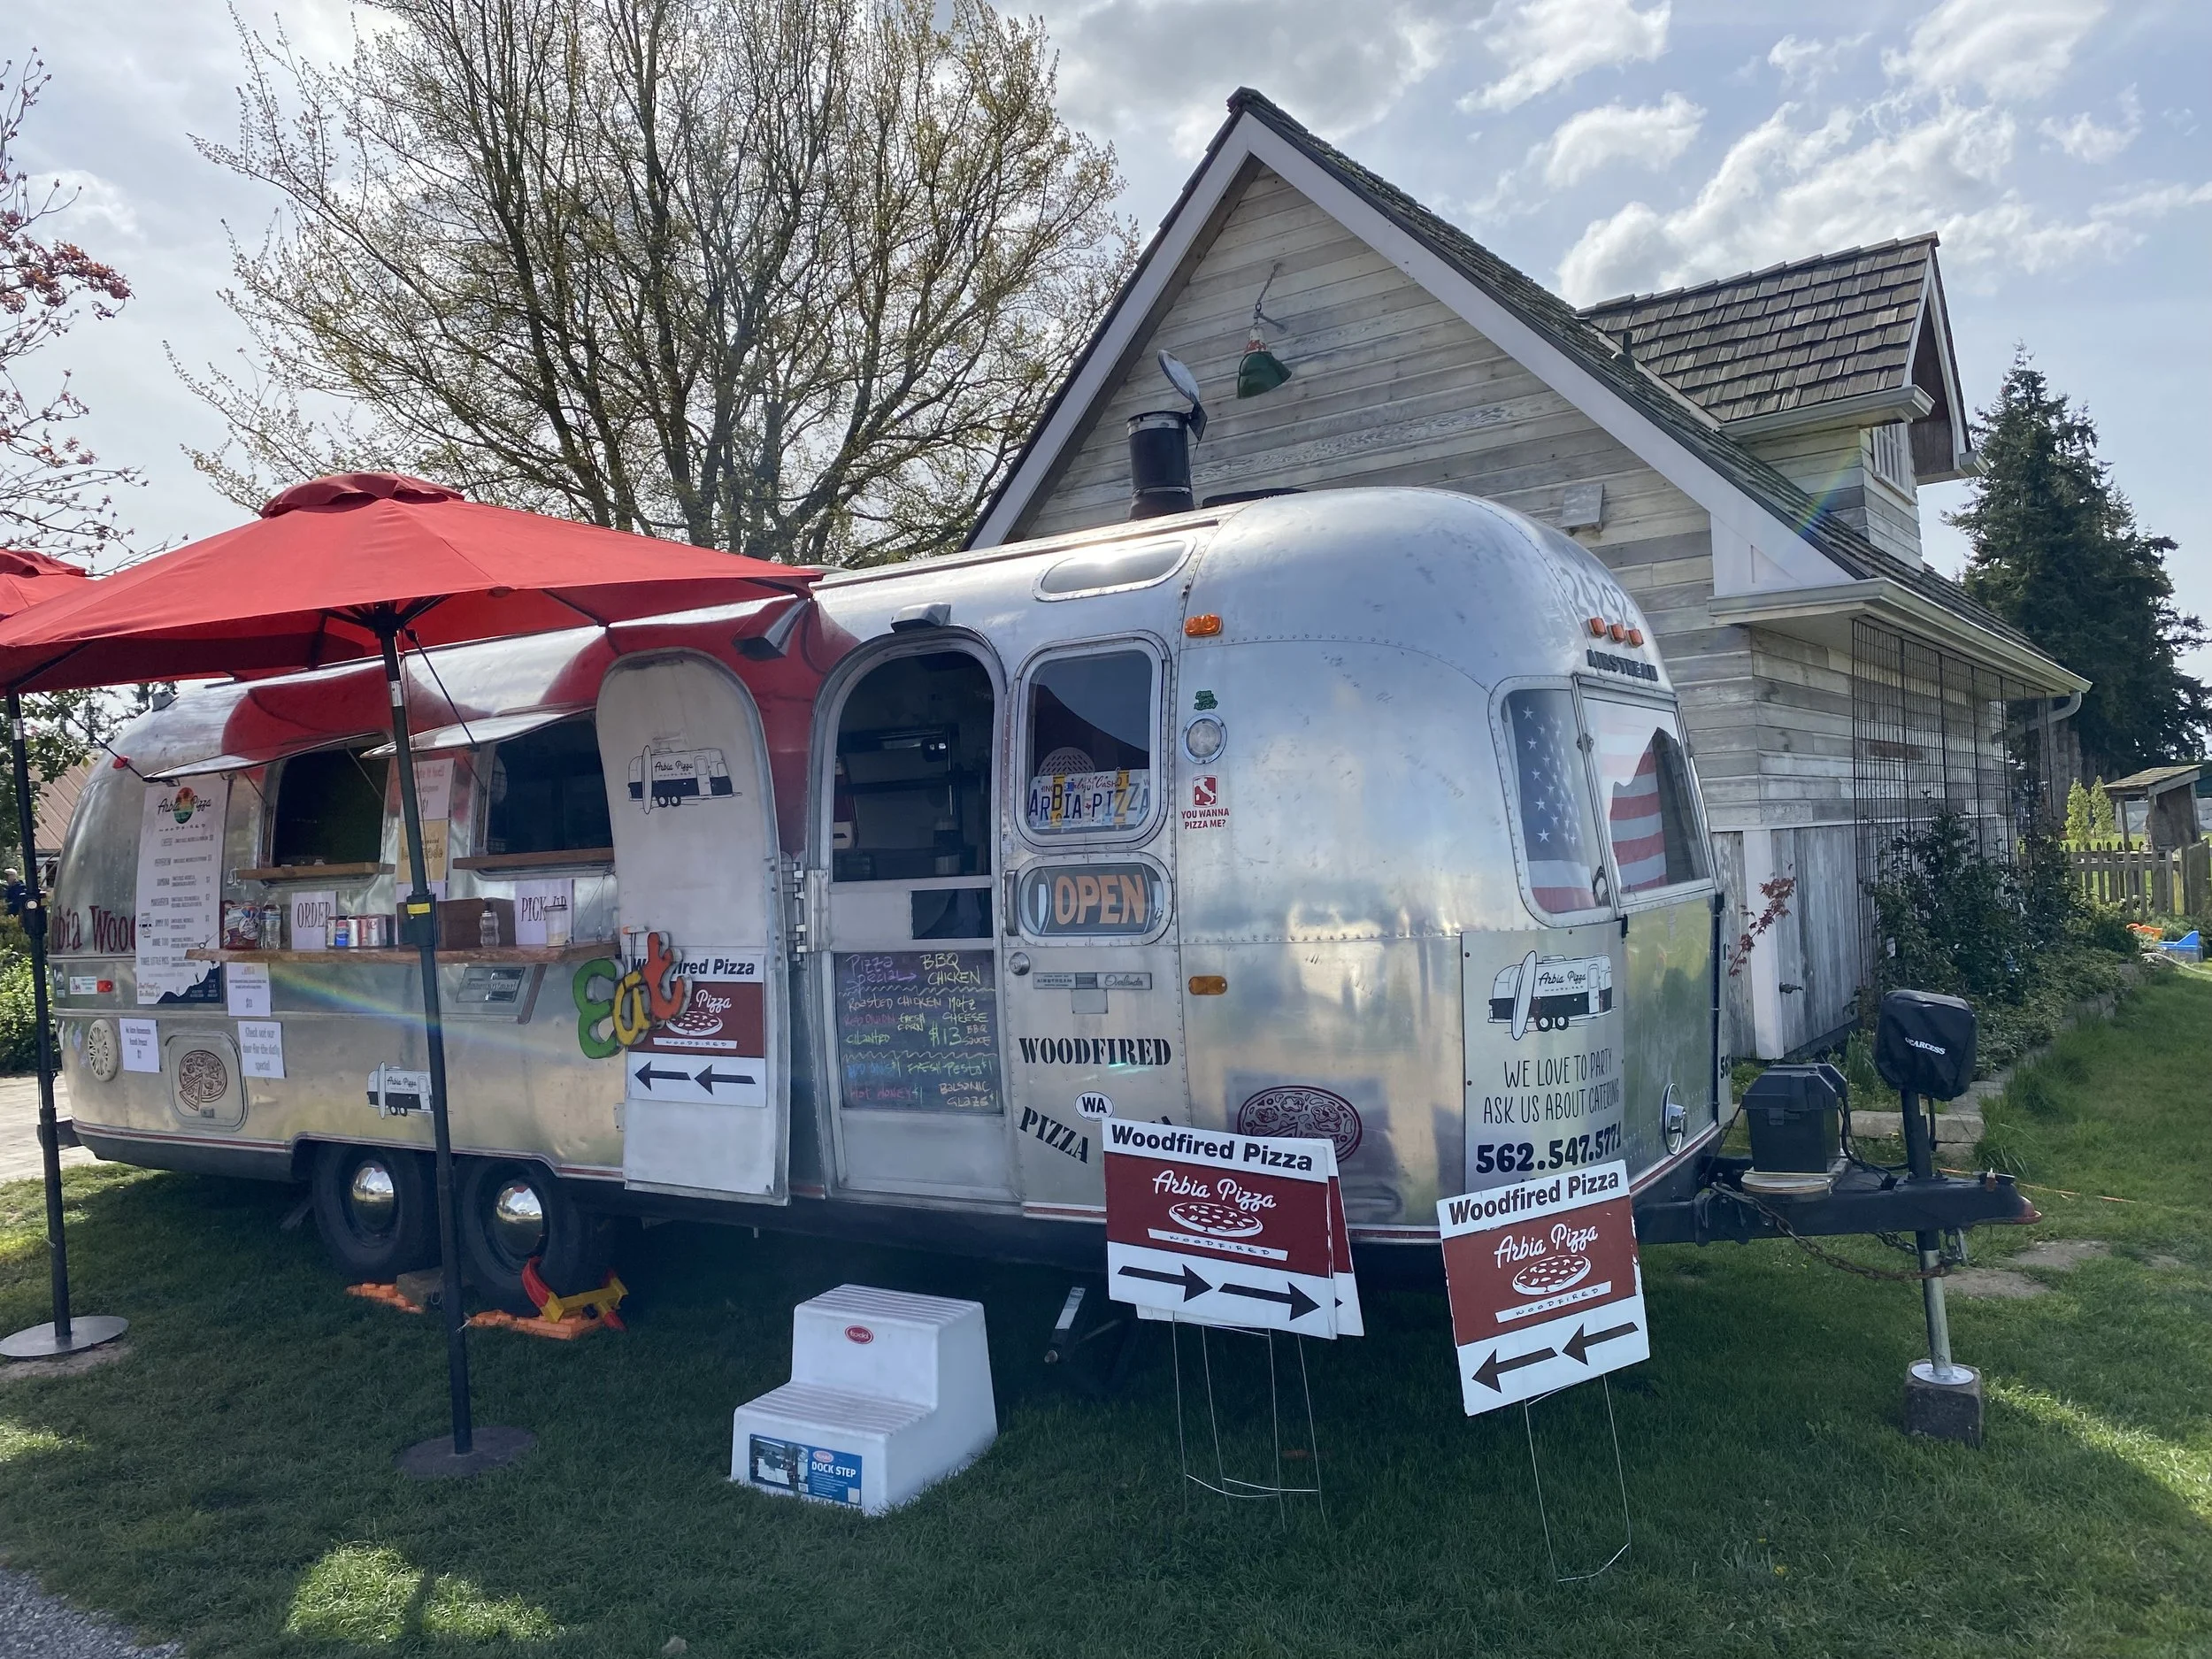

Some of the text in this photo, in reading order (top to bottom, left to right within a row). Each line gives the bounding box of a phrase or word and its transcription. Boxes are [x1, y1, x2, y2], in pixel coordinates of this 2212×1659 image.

[655, 760, 694, 772] Arbia Pizza
[1092, 782, 1149, 818] PIZZA
[1181, 808, 1230, 819] YOU WANNA
[1185, 818, 1226, 830] PIZZA ME?
[521, 895, 547, 921] PICK
[1055, 874, 1145, 926] OPEN
[297, 902, 331, 928] ORDER
[712, 958, 755, 975] Pizza
[920, 952, 960, 972] BBQ
[927, 965, 980, 986] CHICKEN
[1539, 970, 1586, 987] Arbia Pizza
[572, 932, 684, 1059] Eat
[695, 989, 732, 1014] Pizza
[897, 995, 942, 1009] CHICKEN
[942, 1011, 988, 1025] CHEESE
[665, 1039, 728, 1048] WOODFIRED
[929, 1020, 962, 1048] $13
[966, 1024, 987, 1034] BBQ
[1018, 1037, 1171, 1066] WOODFIRED
[1504, 1048, 1613, 1088] WE LOVE TO PARTY
[1081, 1096, 1108, 1114] WA
[1484, 1078, 1620, 1125] ASK US ABOUT CATERING
[1019, 1105, 1089, 1164] PIZZA
[1111, 1124, 1313, 1171] Woodfired Pizza
[1476, 1120, 1622, 1173] 562.547.5771
[1152, 1170, 1278, 1212] Arbia Pizza
[1449, 1171, 1619, 1225] Woodfired Pizza
[1169, 1234, 1271, 1256] WOODFIRED
[1494, 1223, 1599, 1269] Arbia Pizza
[1516, 1287, 1599, 1316] WOODFIRED
[811, 1461, 856, 1479] DOCK STEP
